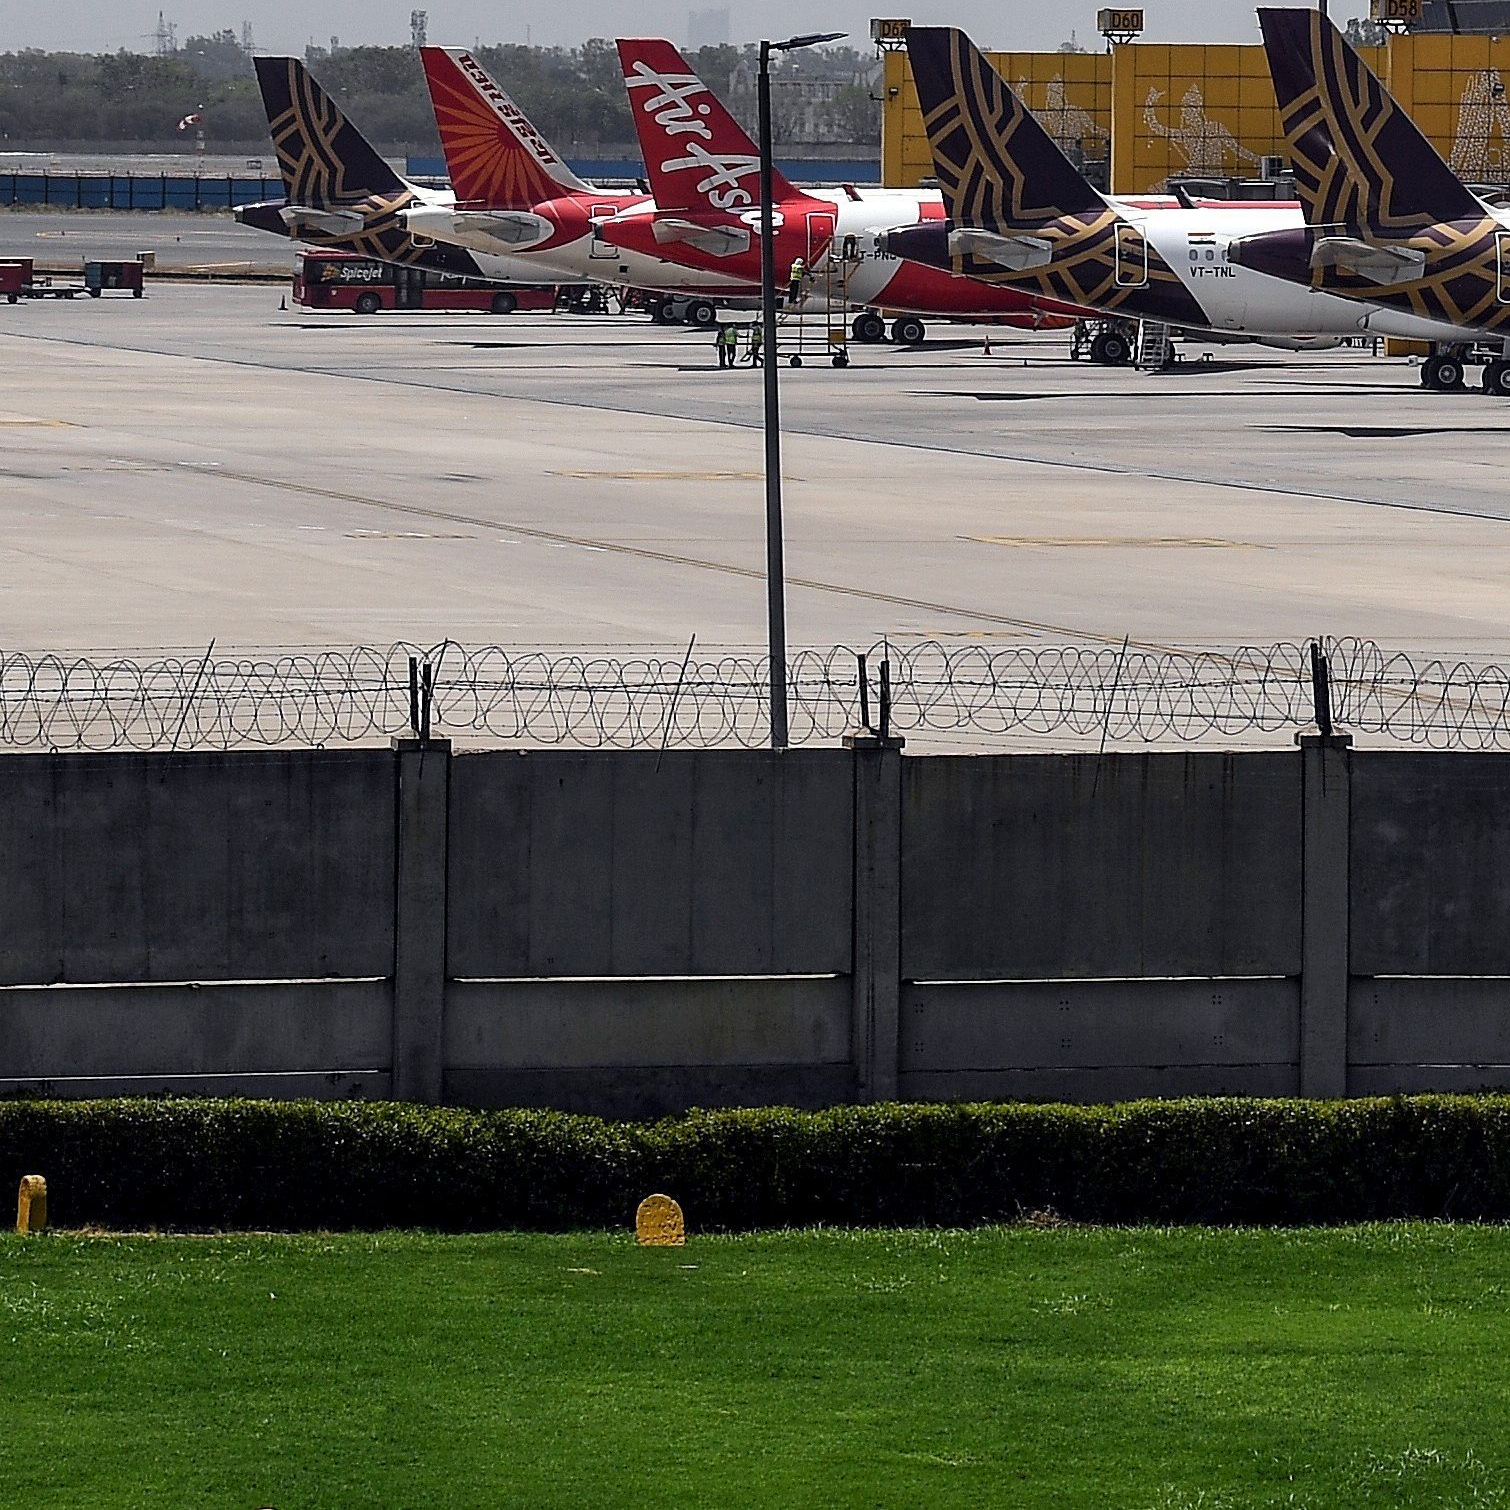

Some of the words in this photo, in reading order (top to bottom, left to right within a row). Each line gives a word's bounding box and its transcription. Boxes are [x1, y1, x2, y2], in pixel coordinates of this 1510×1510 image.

[1388, 0, 1418, 16] D58
[1112, 12, 1139, 28] D60
[1190, 266, 1236, 278] VT-TNL
